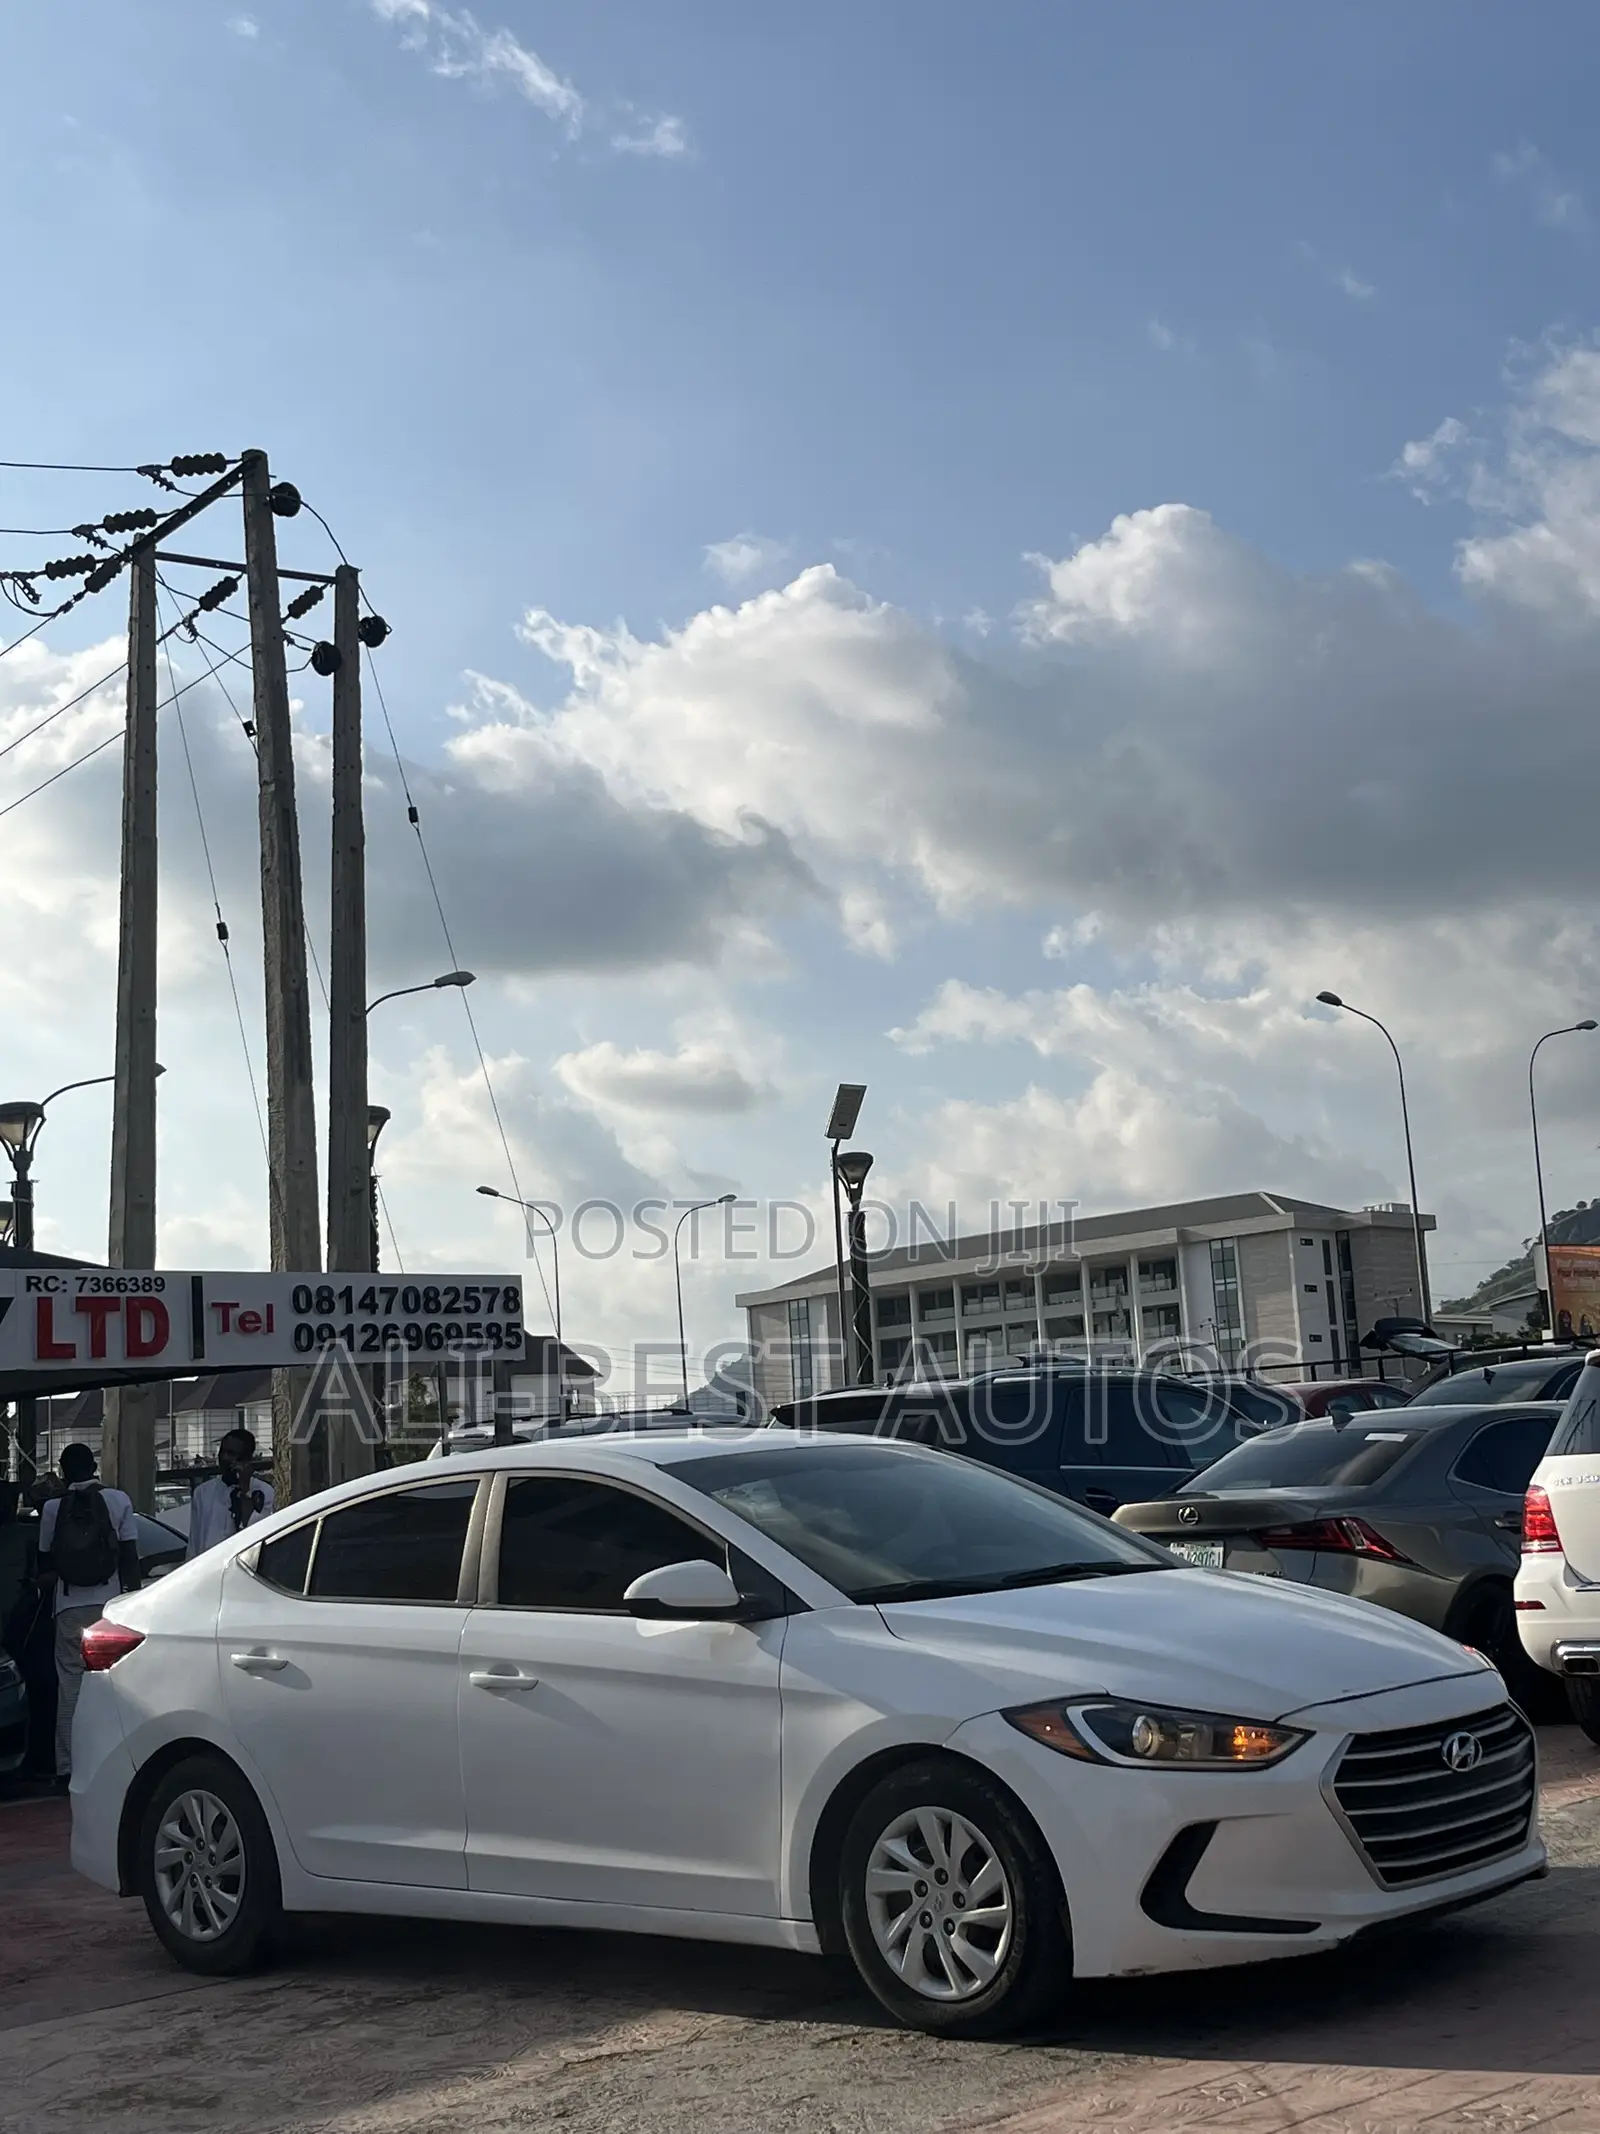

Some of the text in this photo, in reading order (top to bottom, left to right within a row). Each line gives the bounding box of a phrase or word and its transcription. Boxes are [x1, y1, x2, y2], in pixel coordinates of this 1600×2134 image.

[25, 1274, 166, 1294] RC: 7366389
[291, 1283, 522, 1316] 08147082578
[35, 1295, 171, 1360] LTD
[210, 1301, 275, 1334] Tel
[293, 1321, 524, 1353] 09126969585
